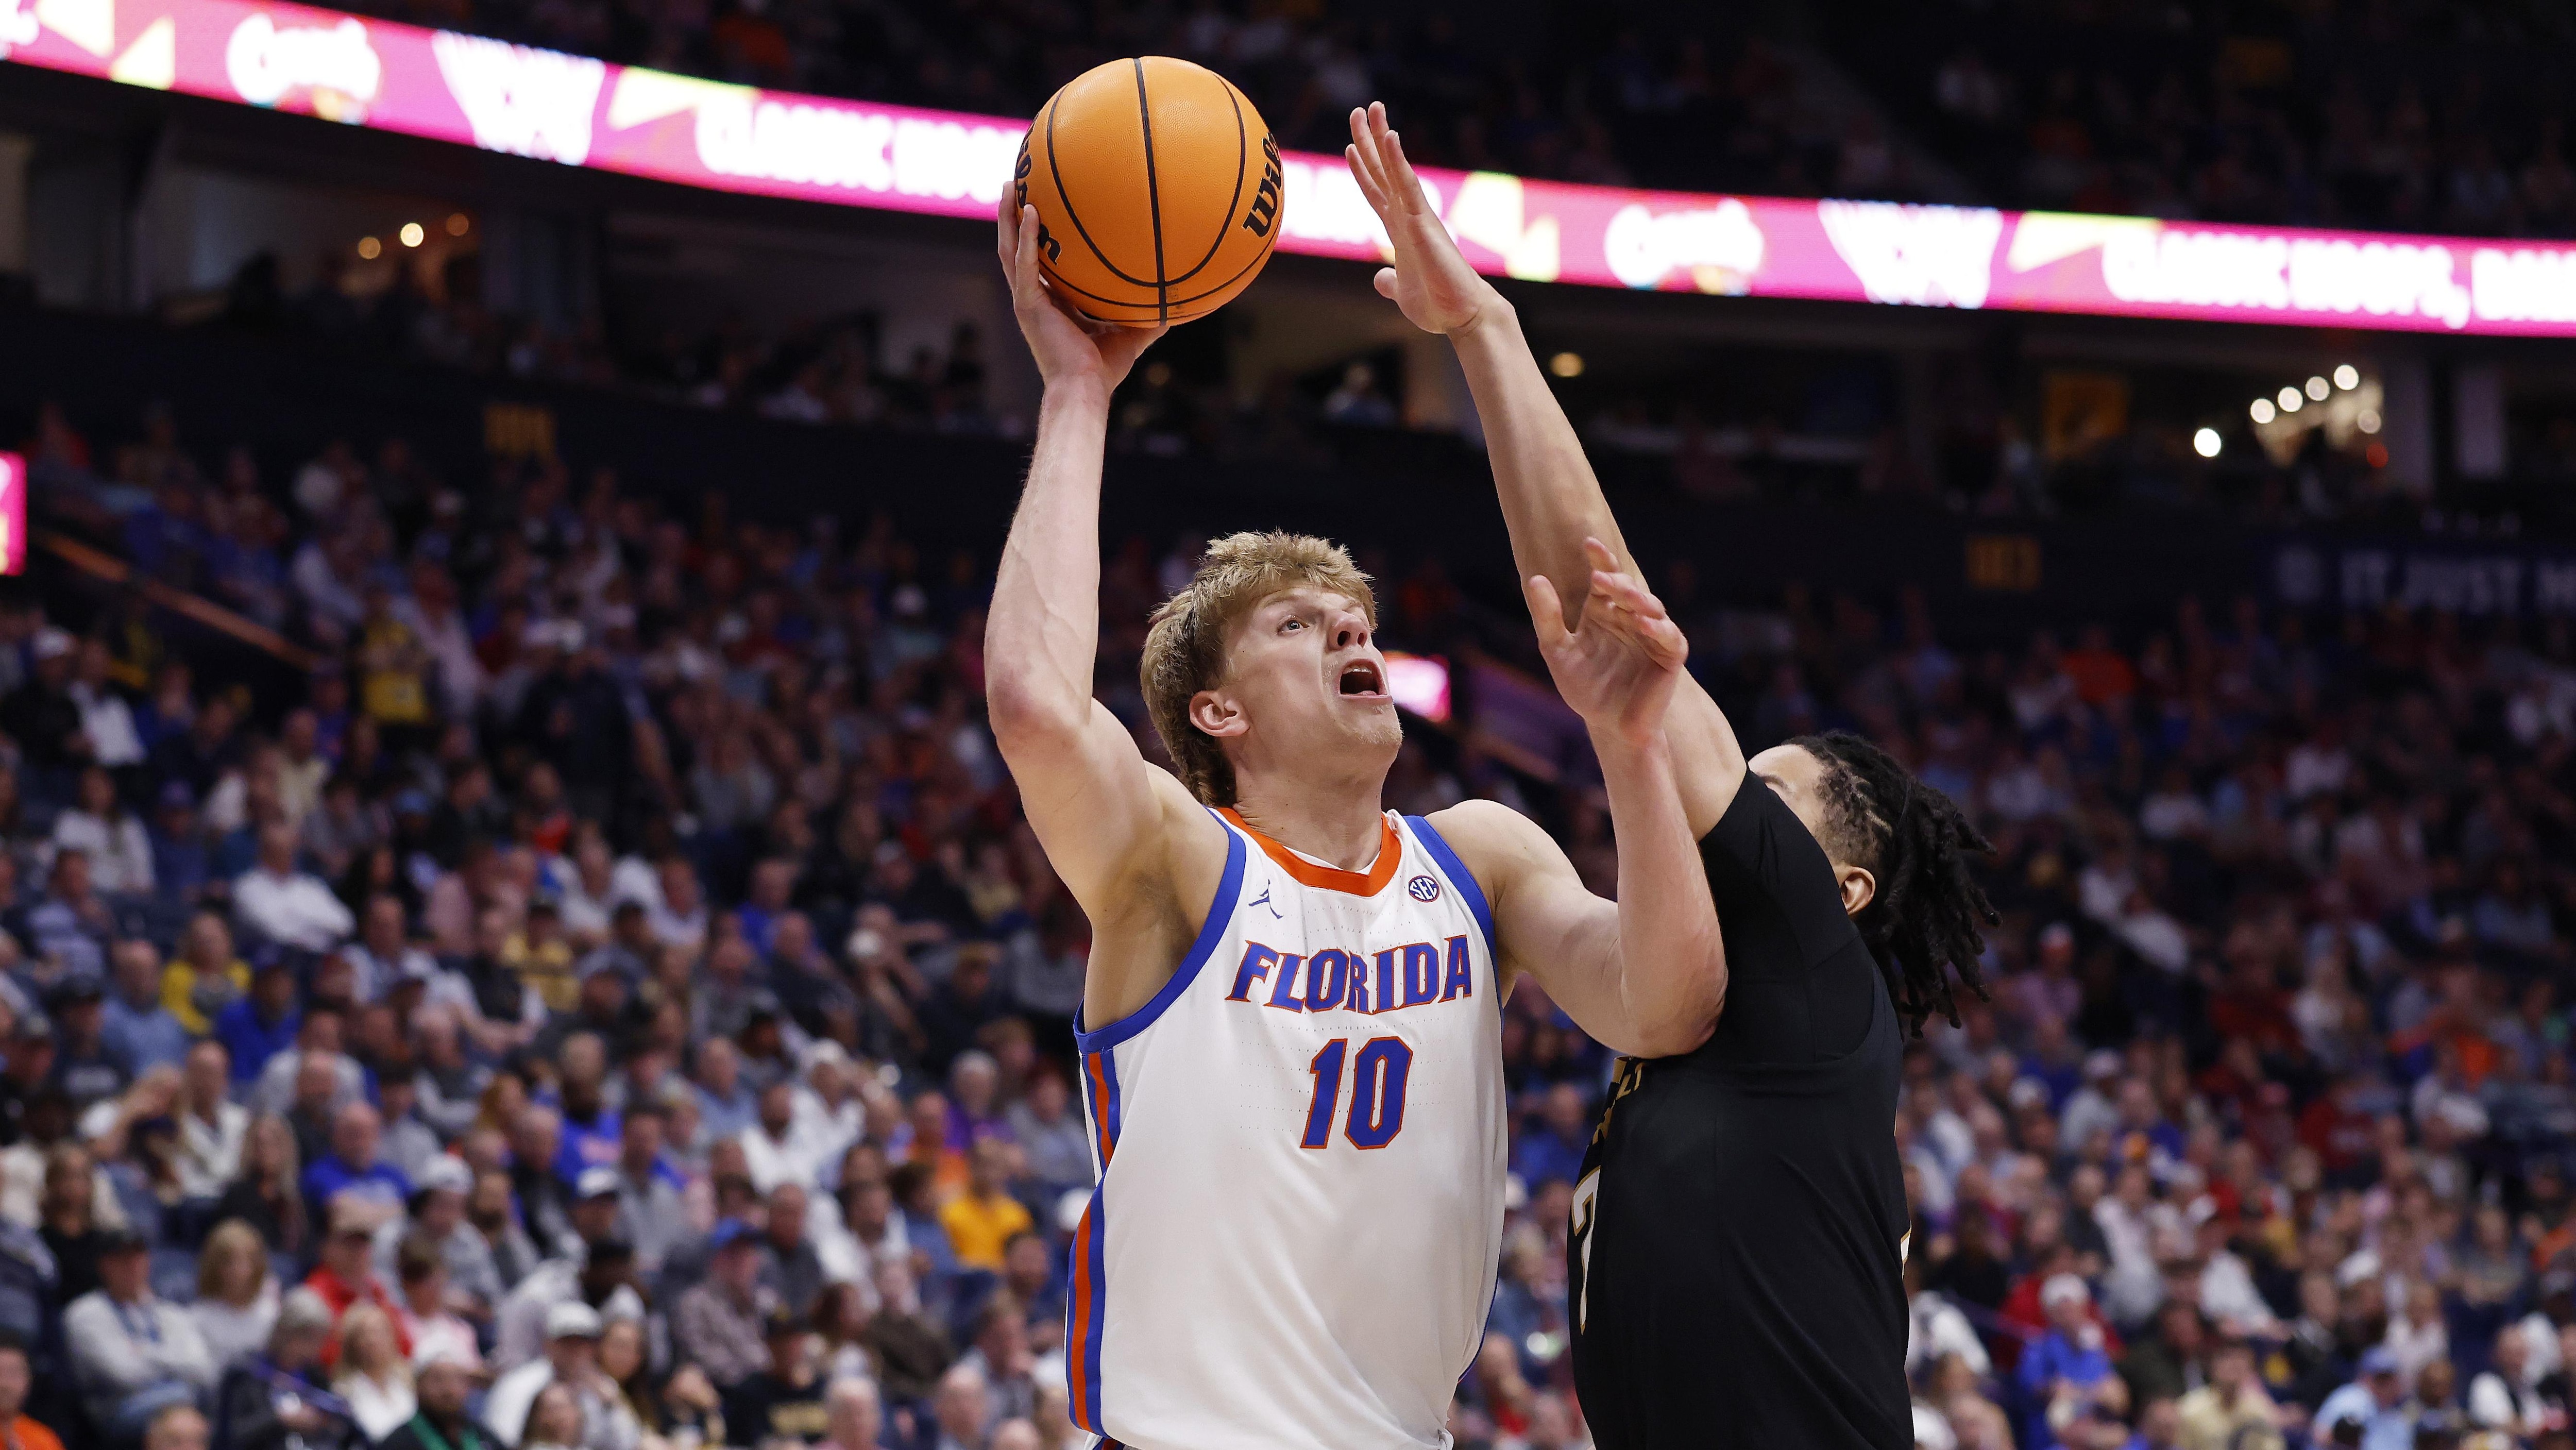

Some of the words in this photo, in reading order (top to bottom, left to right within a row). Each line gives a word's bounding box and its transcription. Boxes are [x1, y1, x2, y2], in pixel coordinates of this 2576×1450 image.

[1409, 877, 1437, 900] SEC
[1225, 934, 1472, 1015] FLORIDA
[1300, 1036, 1413, 1150] 10
